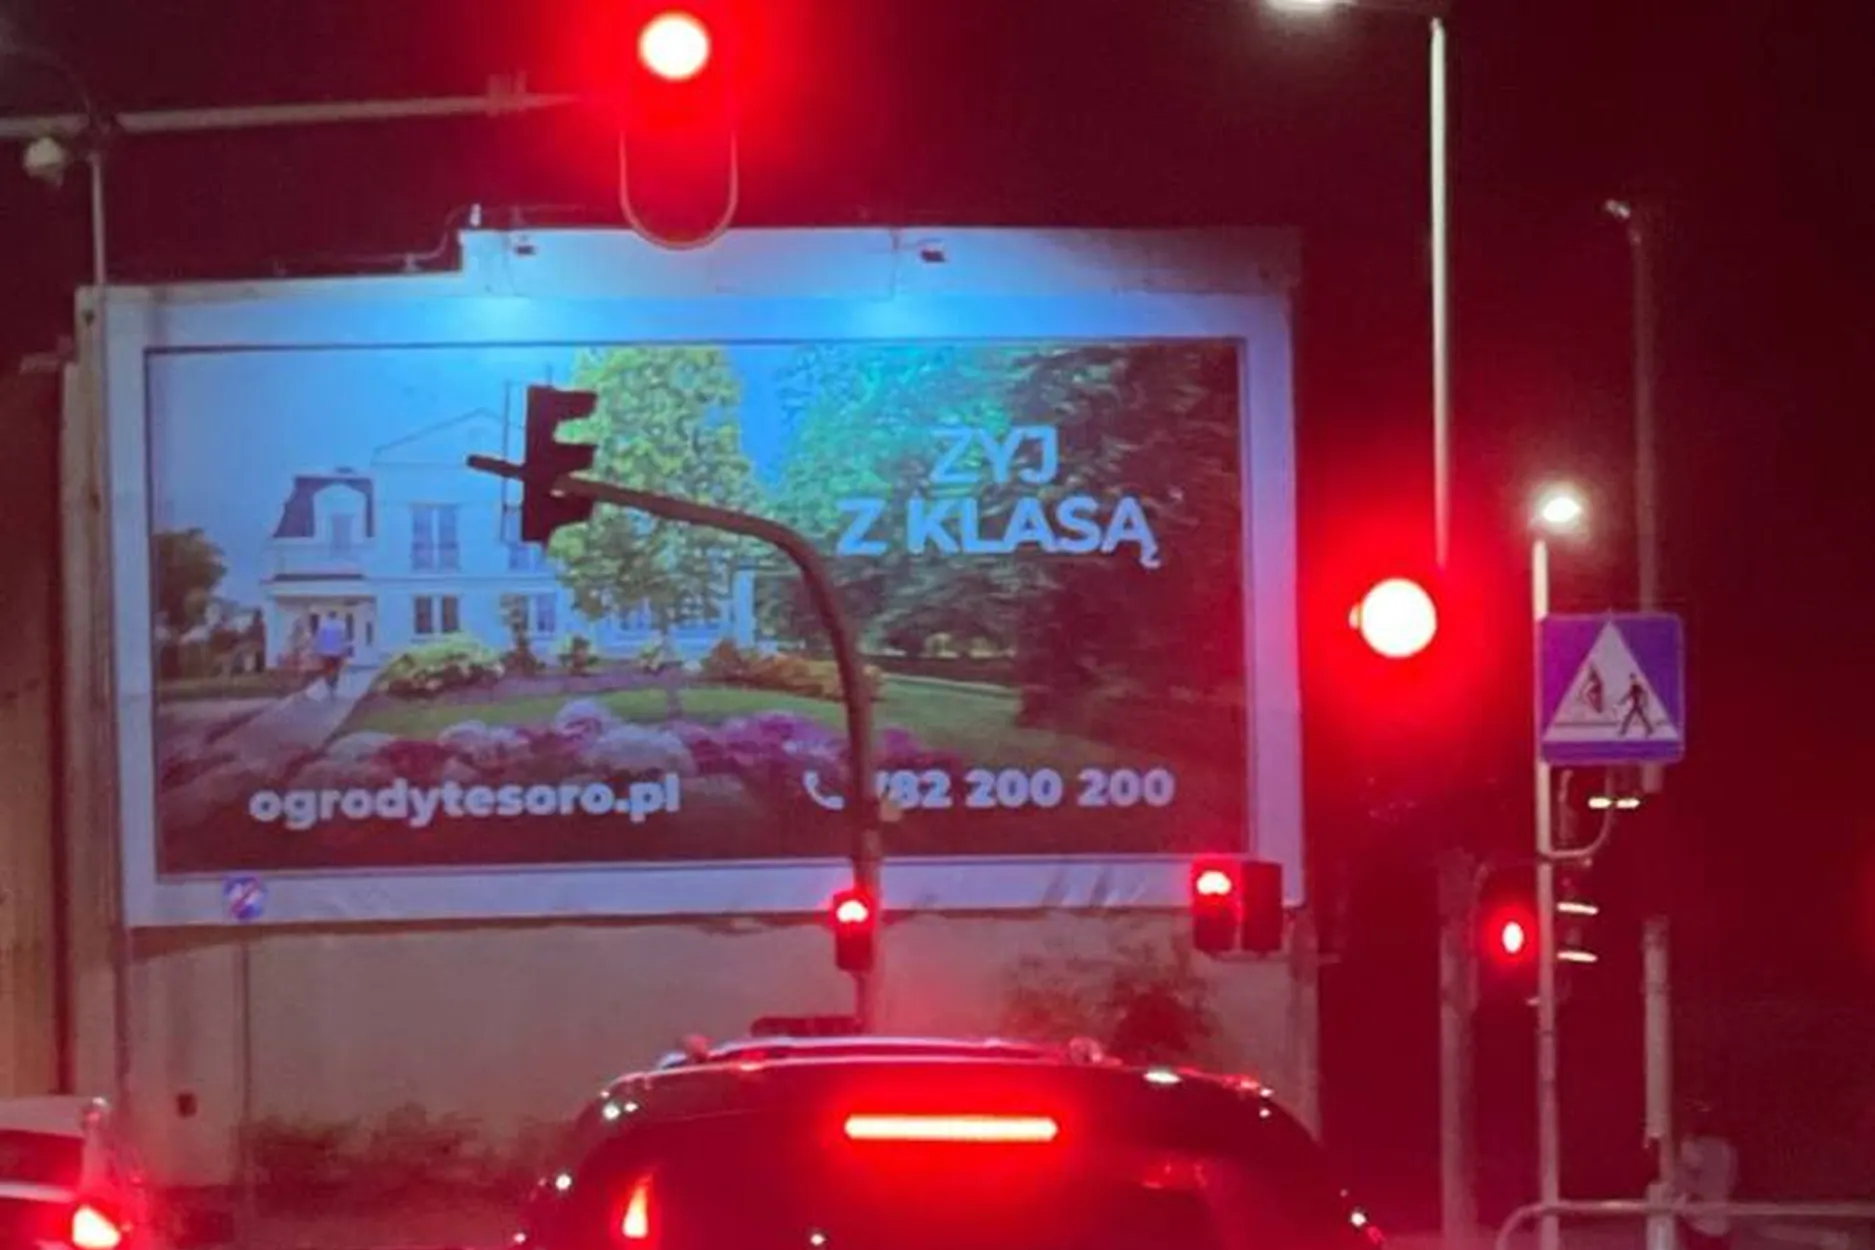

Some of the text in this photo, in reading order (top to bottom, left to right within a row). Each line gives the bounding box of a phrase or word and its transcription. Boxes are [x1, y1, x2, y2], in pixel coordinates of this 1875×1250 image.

[836, 496, 1161, 569] Z KLASĄ
[249, 772, 681, 831] ogrodytesoro.pl
[965, 767, 1063, 808] 200
[1078, 767, 1175, 808] 200
